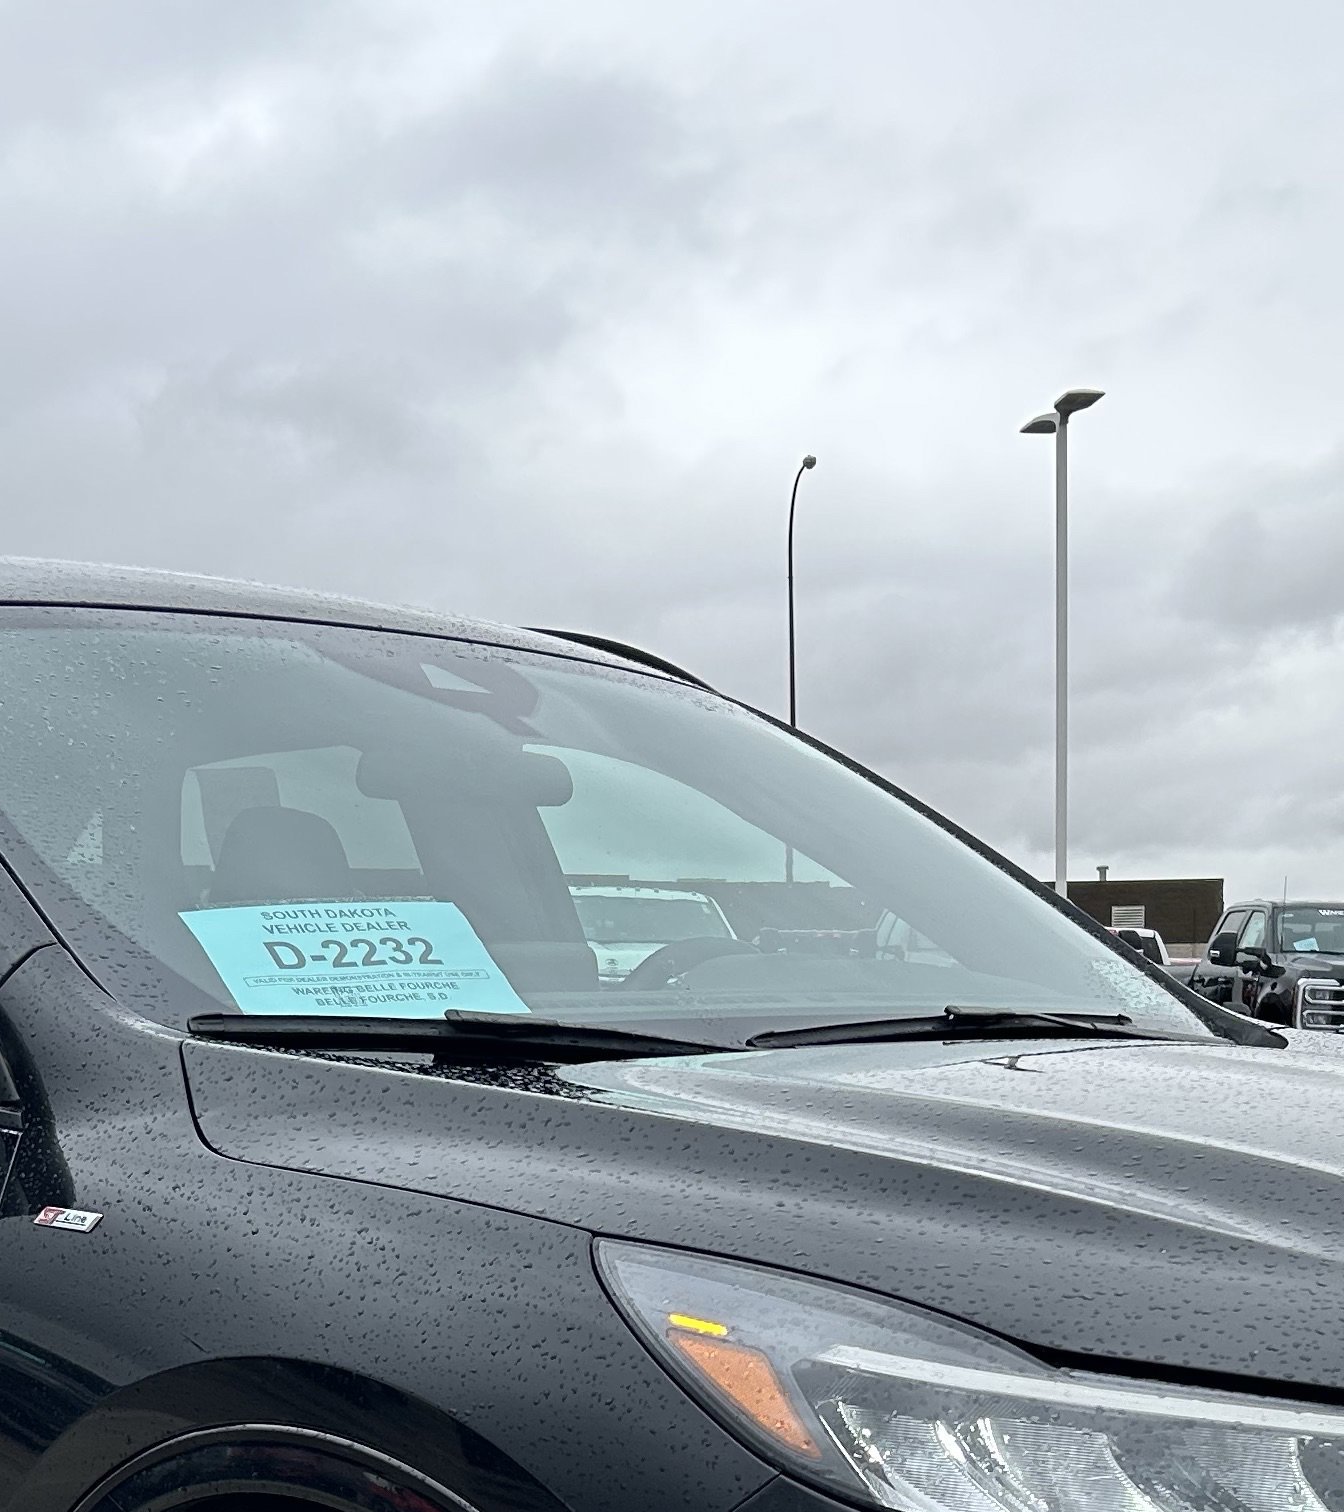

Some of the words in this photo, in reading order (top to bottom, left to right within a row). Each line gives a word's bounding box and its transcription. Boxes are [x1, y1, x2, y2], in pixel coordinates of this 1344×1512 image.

[260, 909, 322, 921] SOUTH
[323, 907, 397, 919] DAKOTA
[262, 922, 339, 934] VEHICLE
[341, 920, 411, 933] DEALER
[263, 936, 444, 971] D-2232
[356, 982, 396, 994] BELLE
[398, 981, 460, 992] FOURCHE
